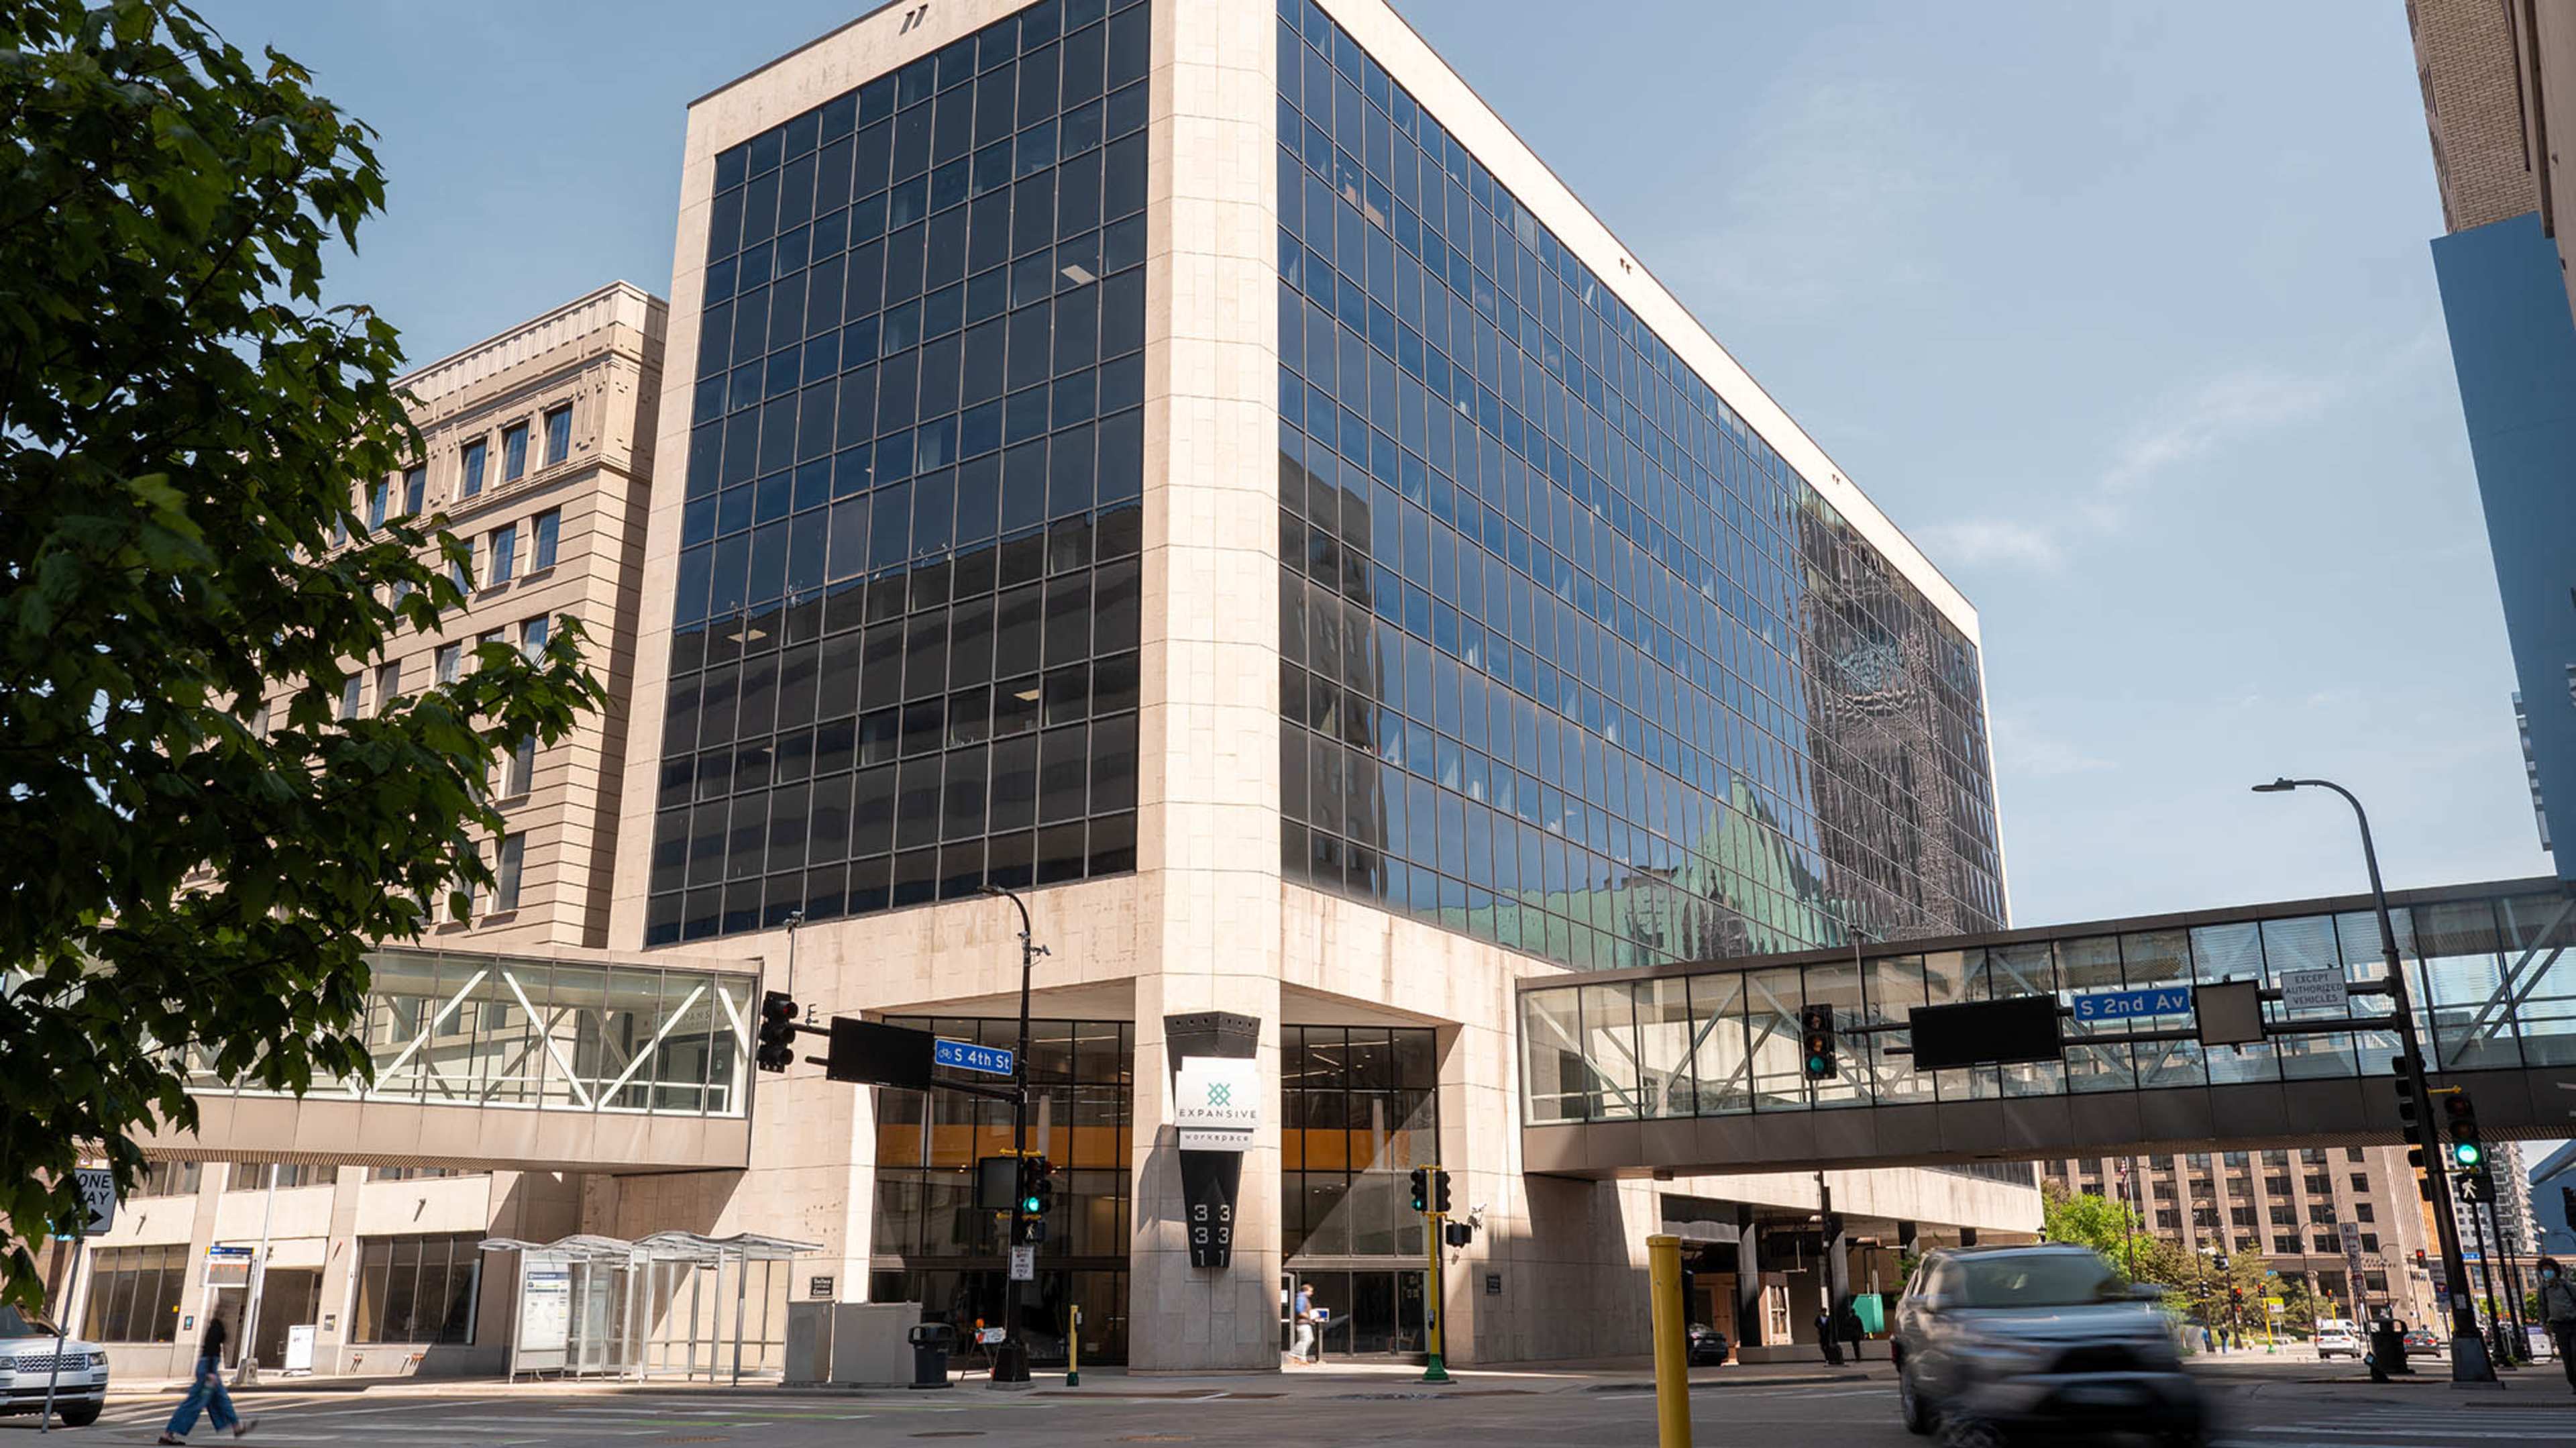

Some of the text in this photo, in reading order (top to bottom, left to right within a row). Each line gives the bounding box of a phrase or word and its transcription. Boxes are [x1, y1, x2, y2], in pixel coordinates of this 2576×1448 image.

[2294, 973, 2329, 984] EXCEPT
[2286, 982, 2343, 994] AUTHORIZED
[2080, 994, 2184, 1016] S 2nd Av
[2292, 994, 2339, 1004] VEHICLES
[954, 1047, 1010, 1070] S 4th St
[1179, 1108, 1256, 1119] EXPANSIVE
[1185, 1133, 1249, 1142] workspace
[78, 1174, 112, 1188] ONE
[81, 1191, 109, 1205] AY
